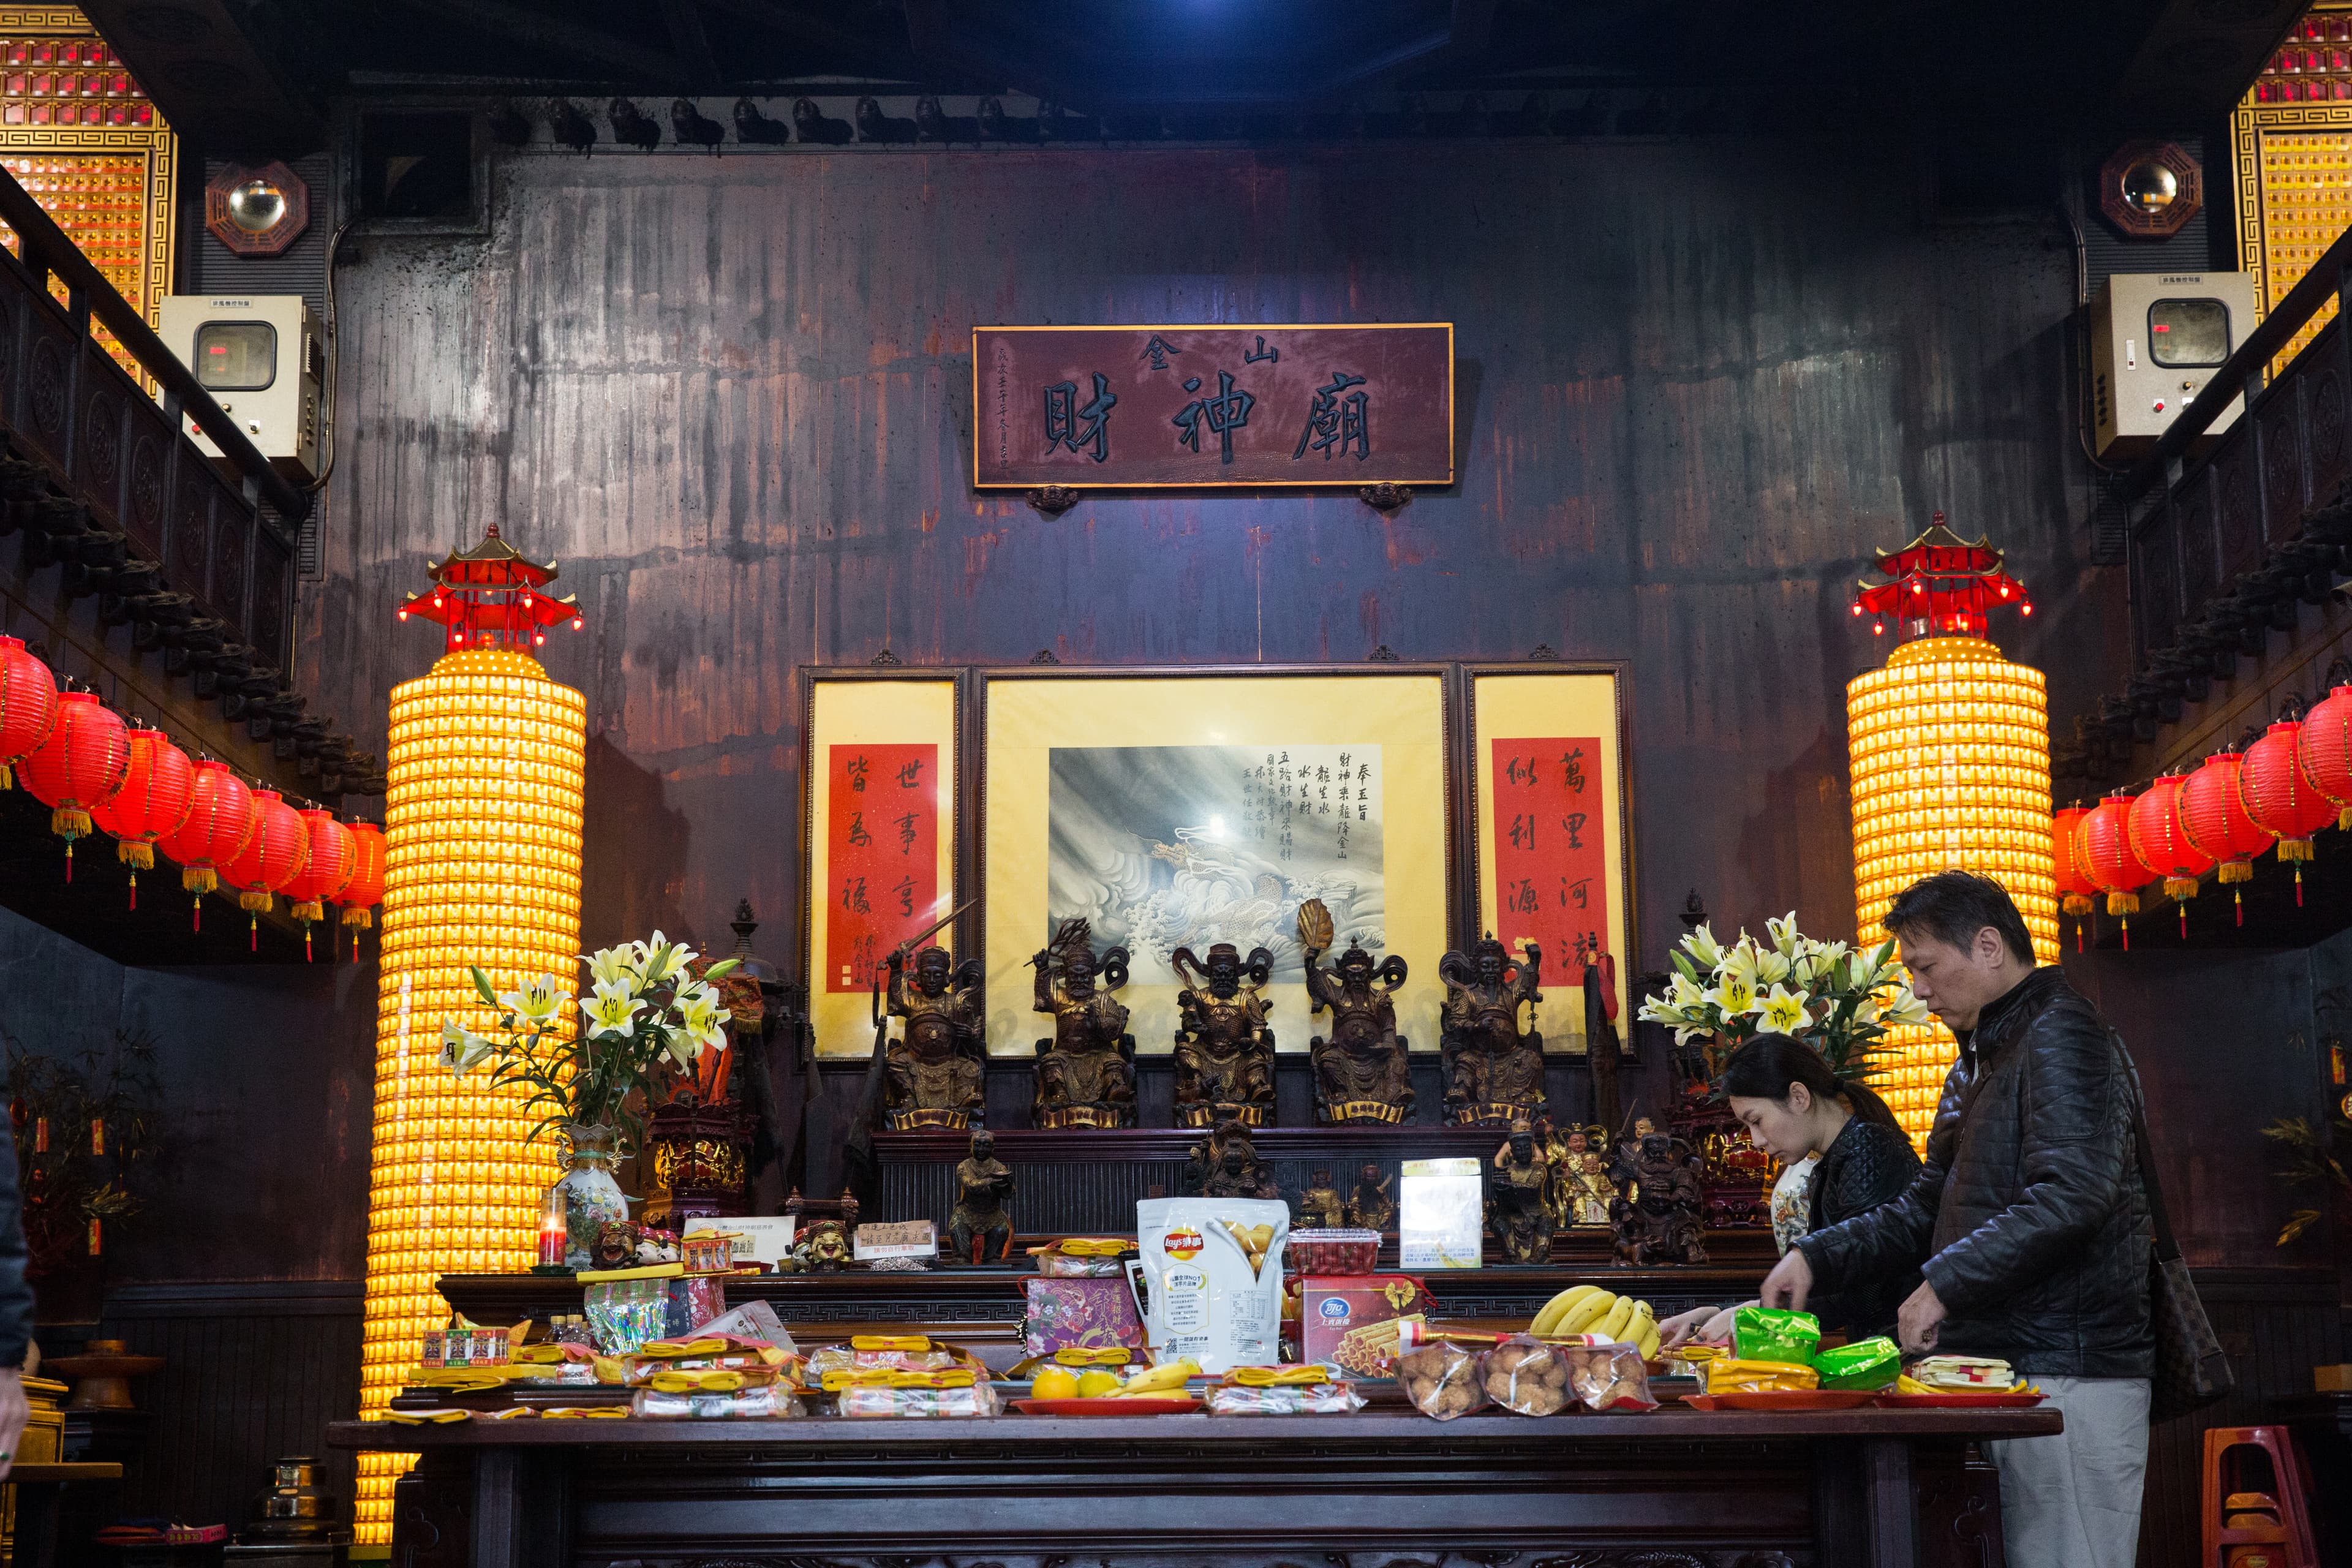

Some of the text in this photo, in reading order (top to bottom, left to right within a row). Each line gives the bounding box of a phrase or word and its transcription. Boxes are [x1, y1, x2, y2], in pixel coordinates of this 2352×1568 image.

[1139, 334, 1278, 370] 金山
[1043, 369, 1370, 465] 財神廟
[1298, 764, 1313, 815] 水生財
[1315, 765, 1331, 815] 龍生水
[1357, 763, 1371, 821] 奉玉旨
